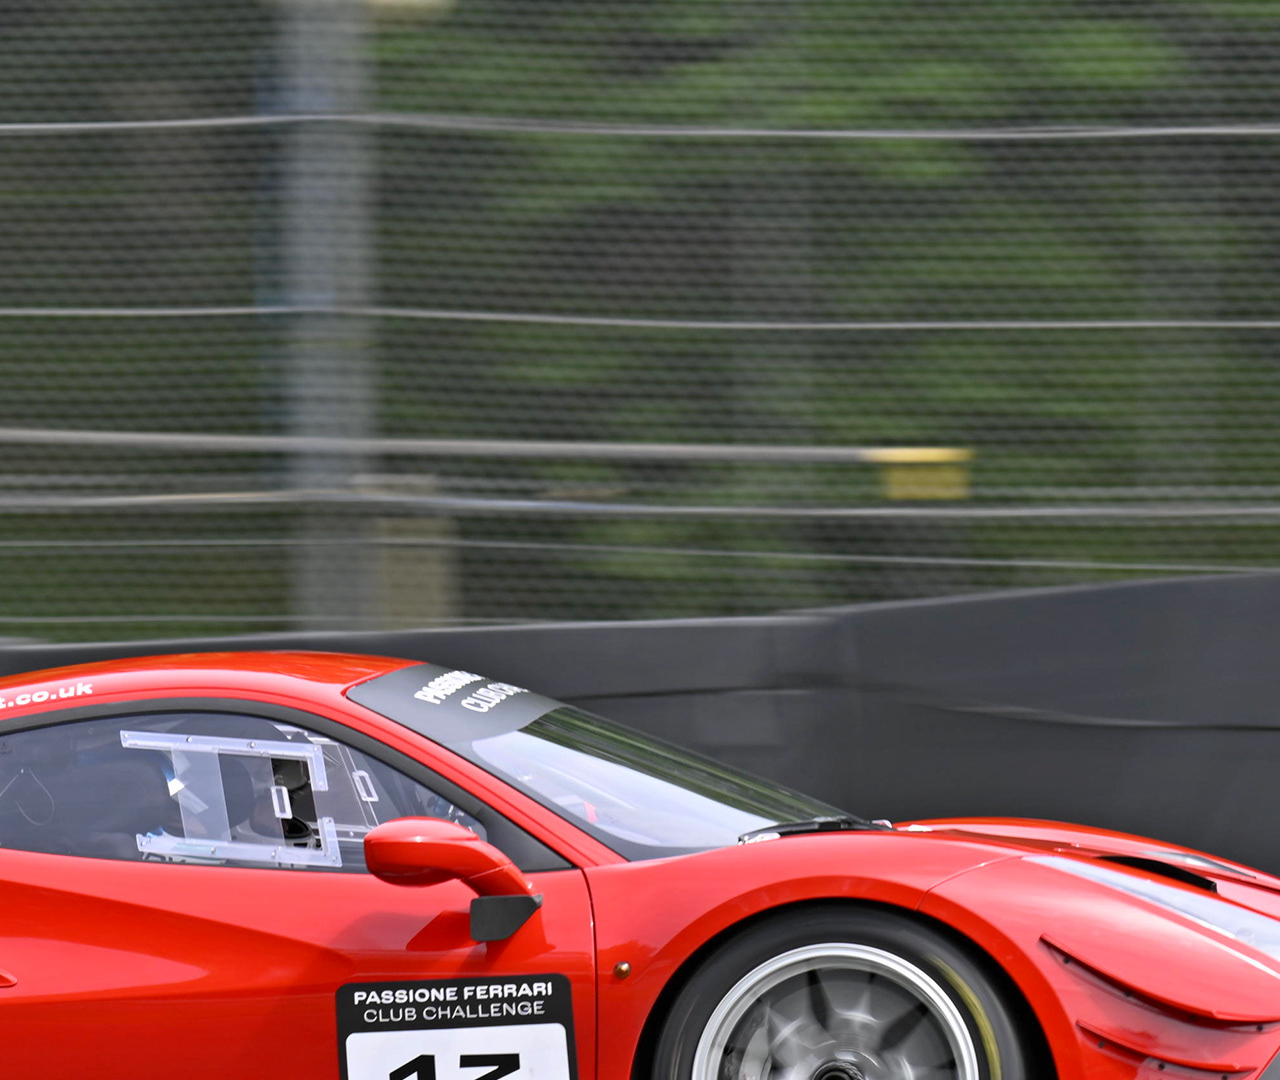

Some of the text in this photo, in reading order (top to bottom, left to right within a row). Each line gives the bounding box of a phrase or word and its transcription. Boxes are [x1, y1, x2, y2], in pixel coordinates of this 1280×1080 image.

[353, 981, 553, 1005] PASSIONE FERRARI
[363, 1000, 546, 1023] CLUB CHALLENGE
